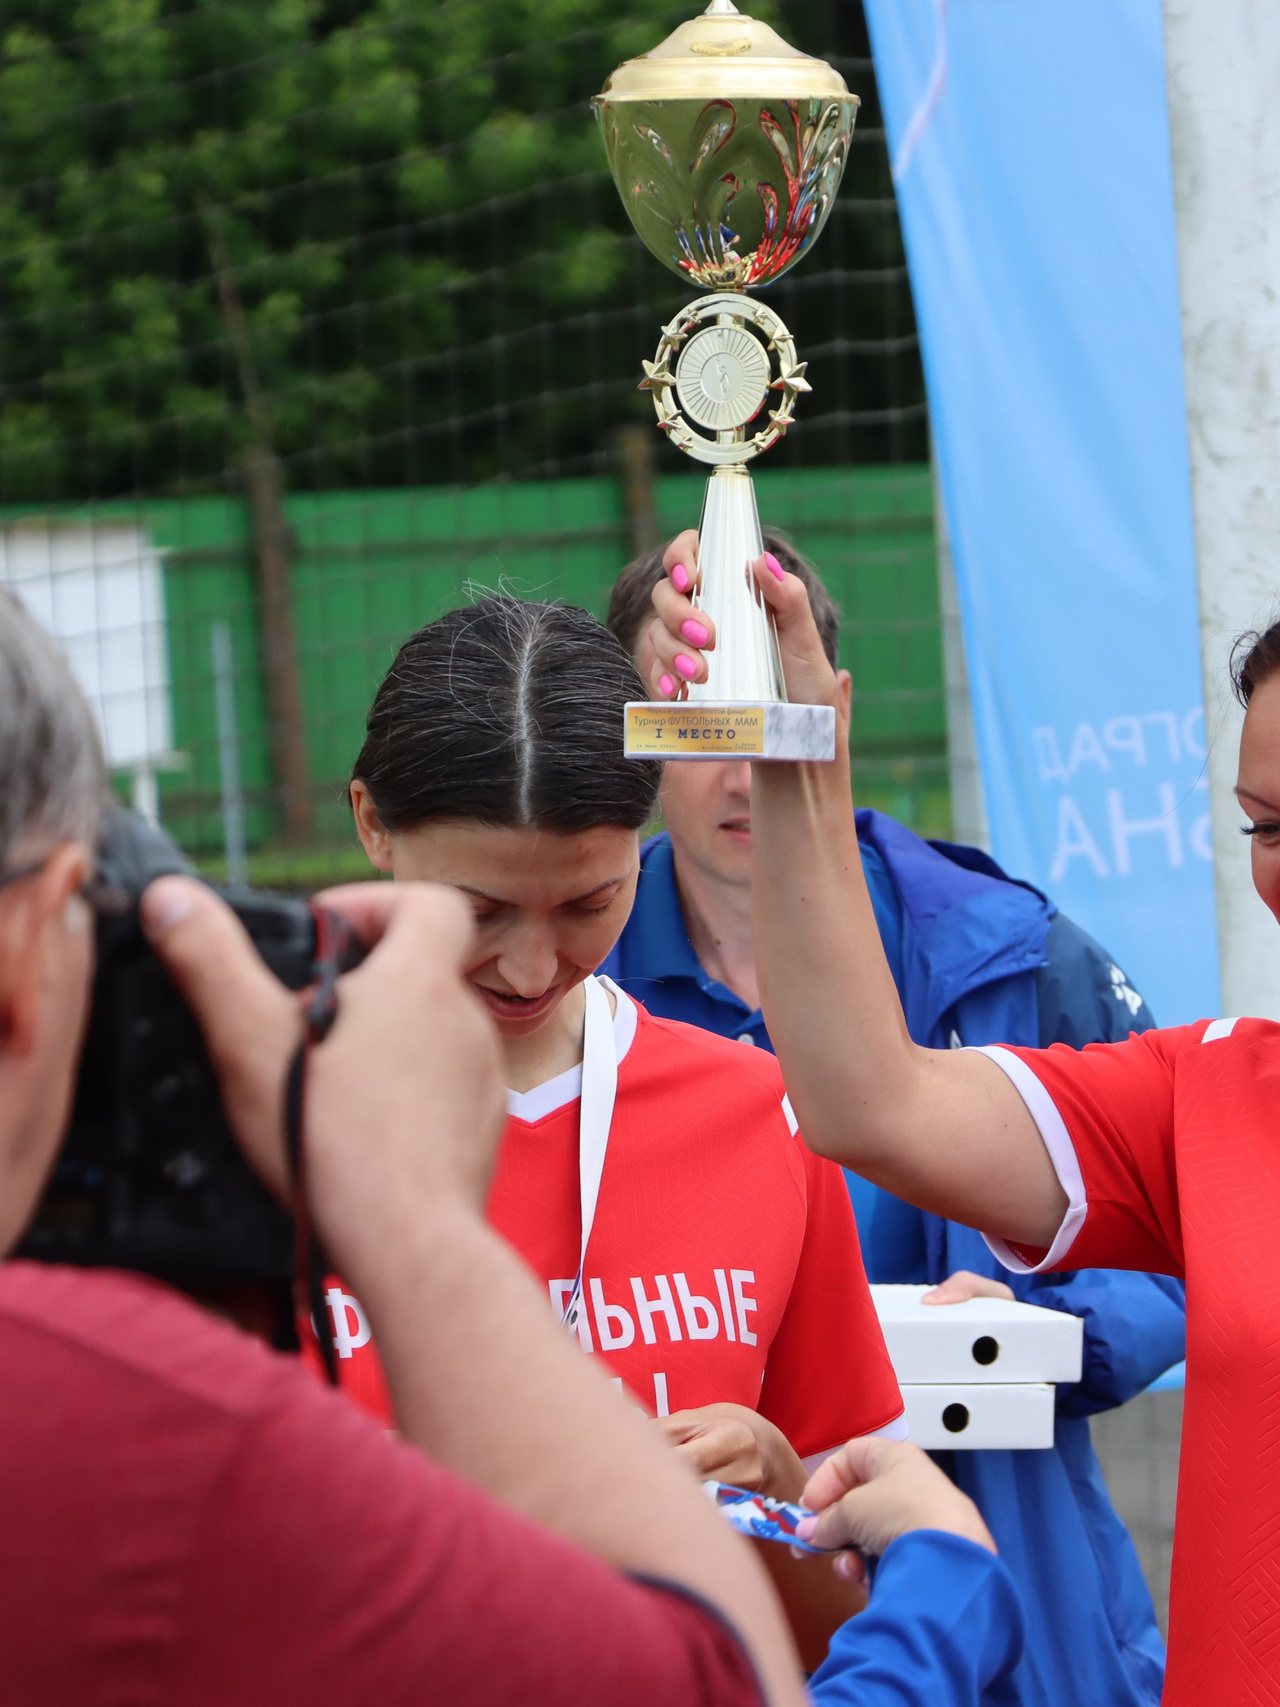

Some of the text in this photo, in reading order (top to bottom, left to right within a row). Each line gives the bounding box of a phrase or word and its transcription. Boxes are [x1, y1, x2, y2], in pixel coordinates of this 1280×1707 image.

[634, 716, 758, 727] Турнир ФУТБОЛЬНЫХ МАМ
[655, 728, 736, 740] I МЕСТО
